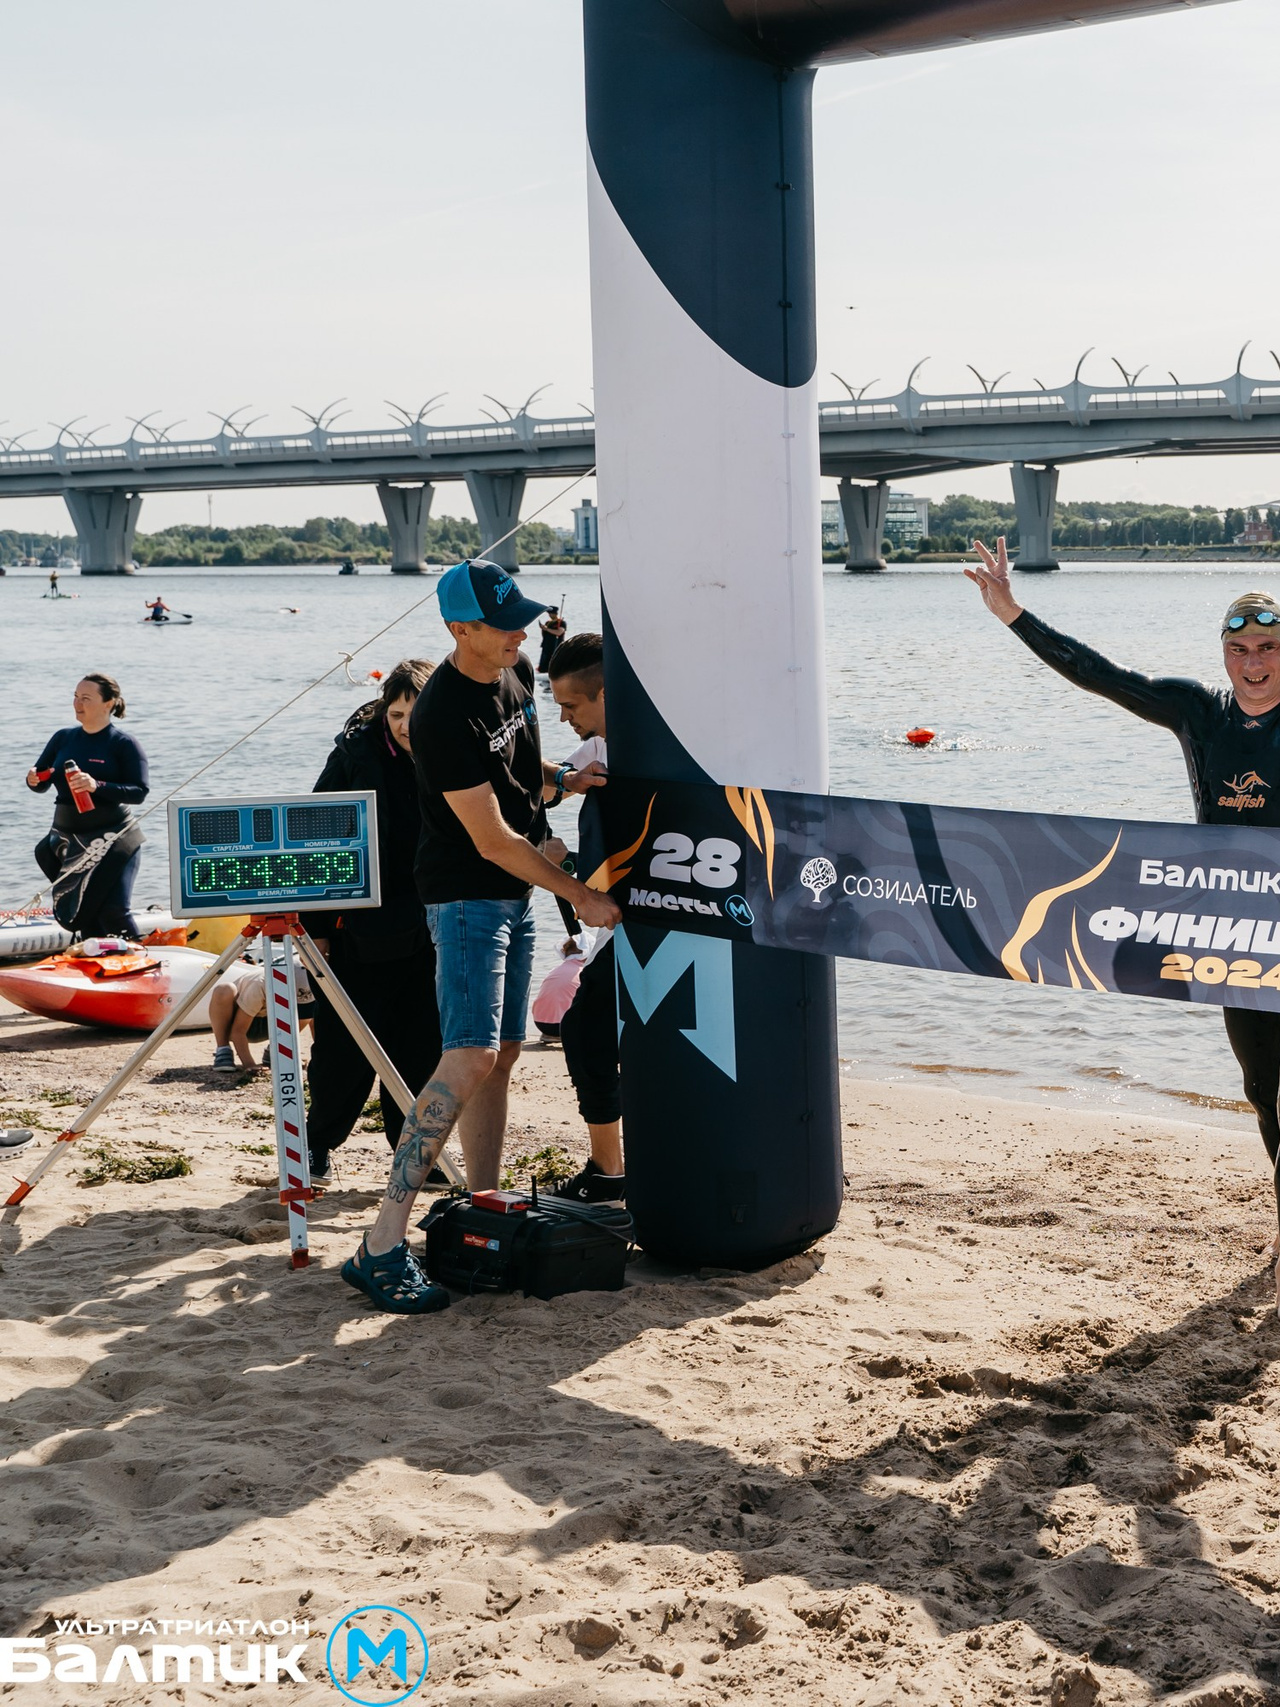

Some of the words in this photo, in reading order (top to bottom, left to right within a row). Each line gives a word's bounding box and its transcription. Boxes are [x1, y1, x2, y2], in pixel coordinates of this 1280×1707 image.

[1217, 793, 1266, 812] sailfish
[212, 844, 254, 852] СТАРТ/START
[304, 840, 341, 848] НОМЕР/BIB
[649, 832, 742, 889] 28
[842, 874, 979, 909] СОЗИДАТЕЛЬ
[280, 1072, 297, 1108] RGK
